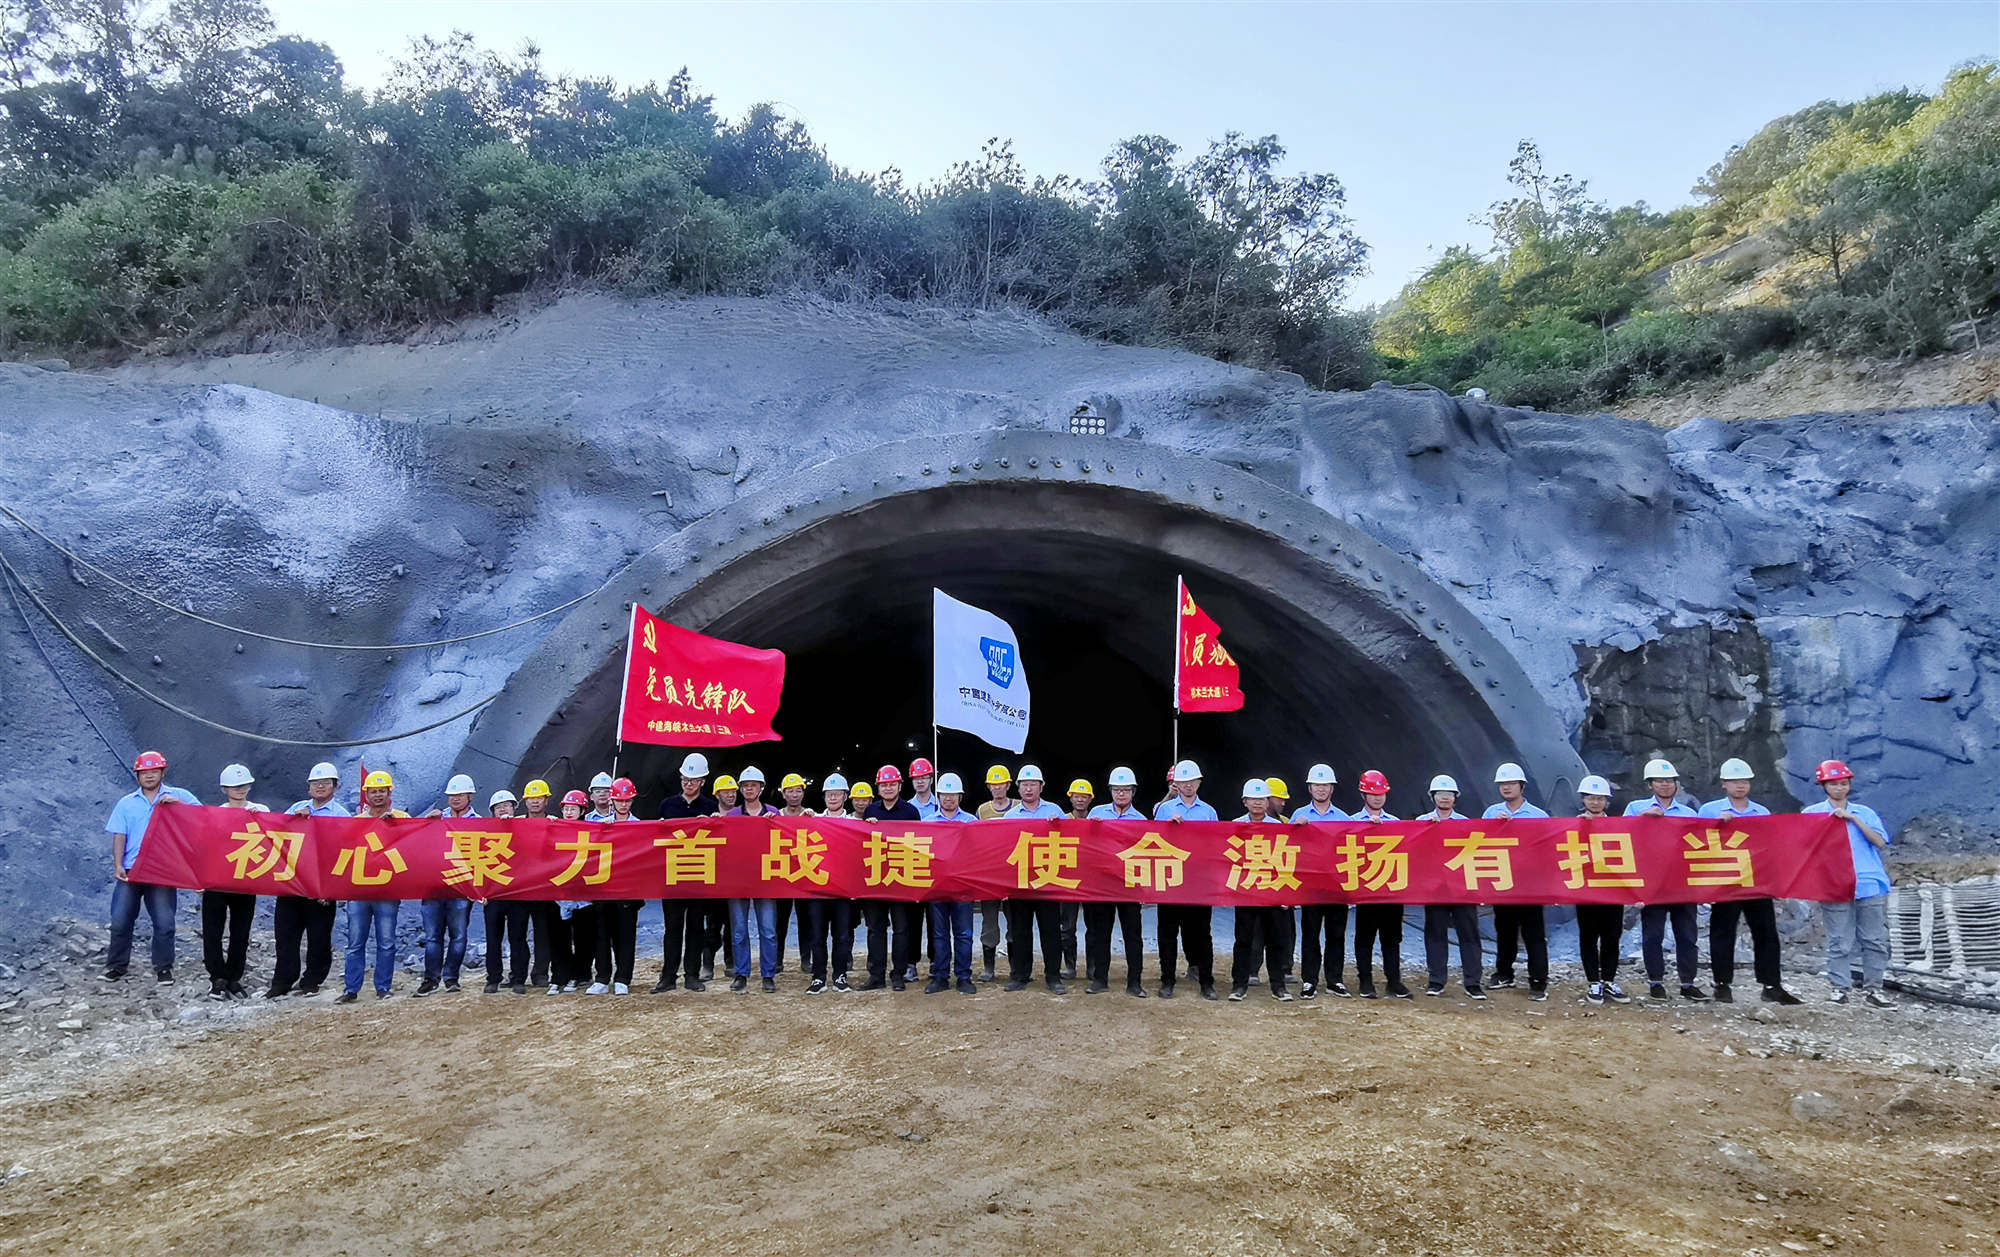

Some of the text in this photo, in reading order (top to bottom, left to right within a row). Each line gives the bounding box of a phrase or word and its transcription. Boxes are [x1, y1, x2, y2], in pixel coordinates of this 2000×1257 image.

[227, 823, 1754, 890] 初心聚力首战捷 使命激扬有担当
